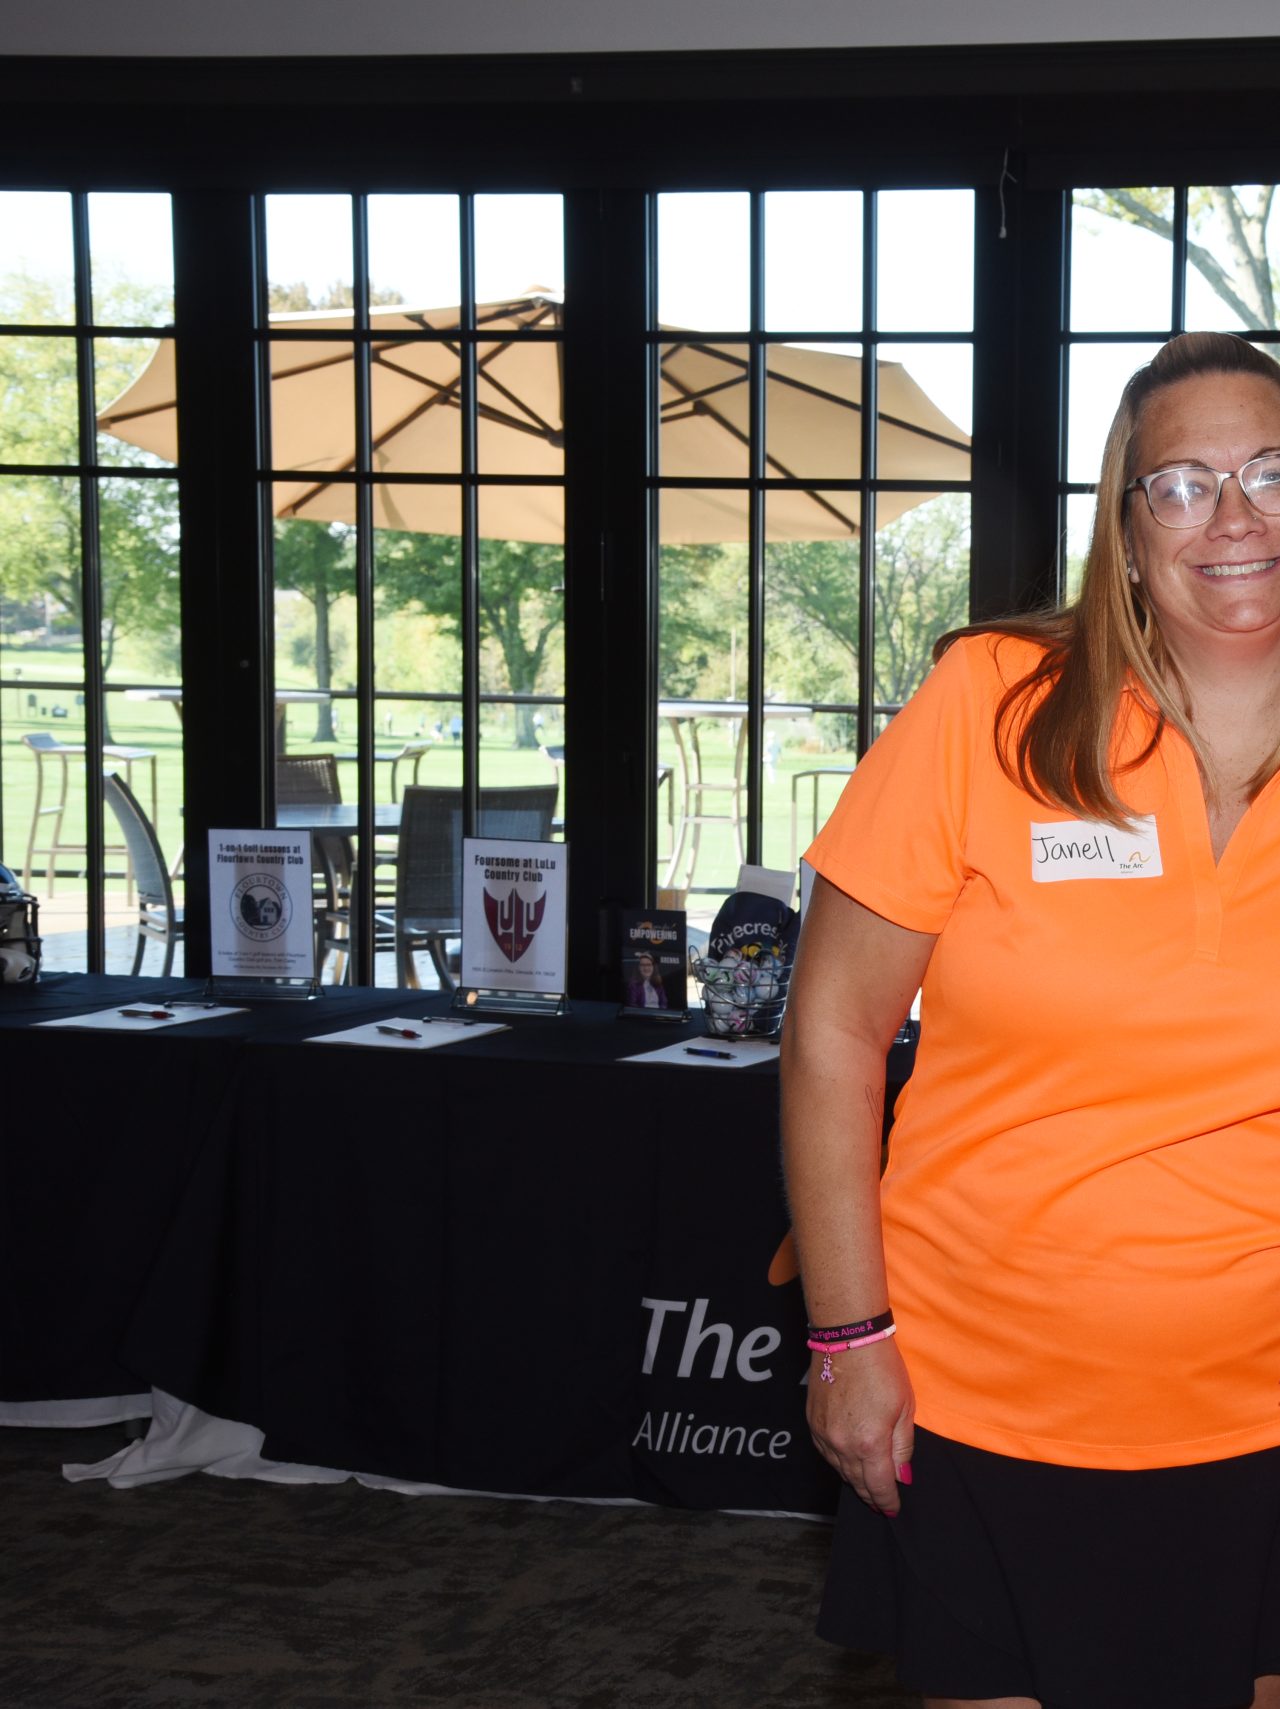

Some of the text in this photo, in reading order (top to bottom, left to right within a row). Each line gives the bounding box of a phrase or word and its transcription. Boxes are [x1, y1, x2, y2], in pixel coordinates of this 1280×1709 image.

[260, 844, 291, 853] Lessons
[293, 845, 301, 853] at
[1032, 836, 1115, 864] Janell
[256, 855, 285, 865] Country
[287, 856, 304, 864] Club
[474, 854, 556, 870] Foursome at LuLu
[484, 868, 543, 882] Country Club
[630, 928, 677, 941] EMPOWERING
[641, 1296, 782, 1382] The
[818, 1330, 840, 1341] Fights
[841, 1326, 866, 1337] Alone
[631, 1411, 792, 1459] Alliance
